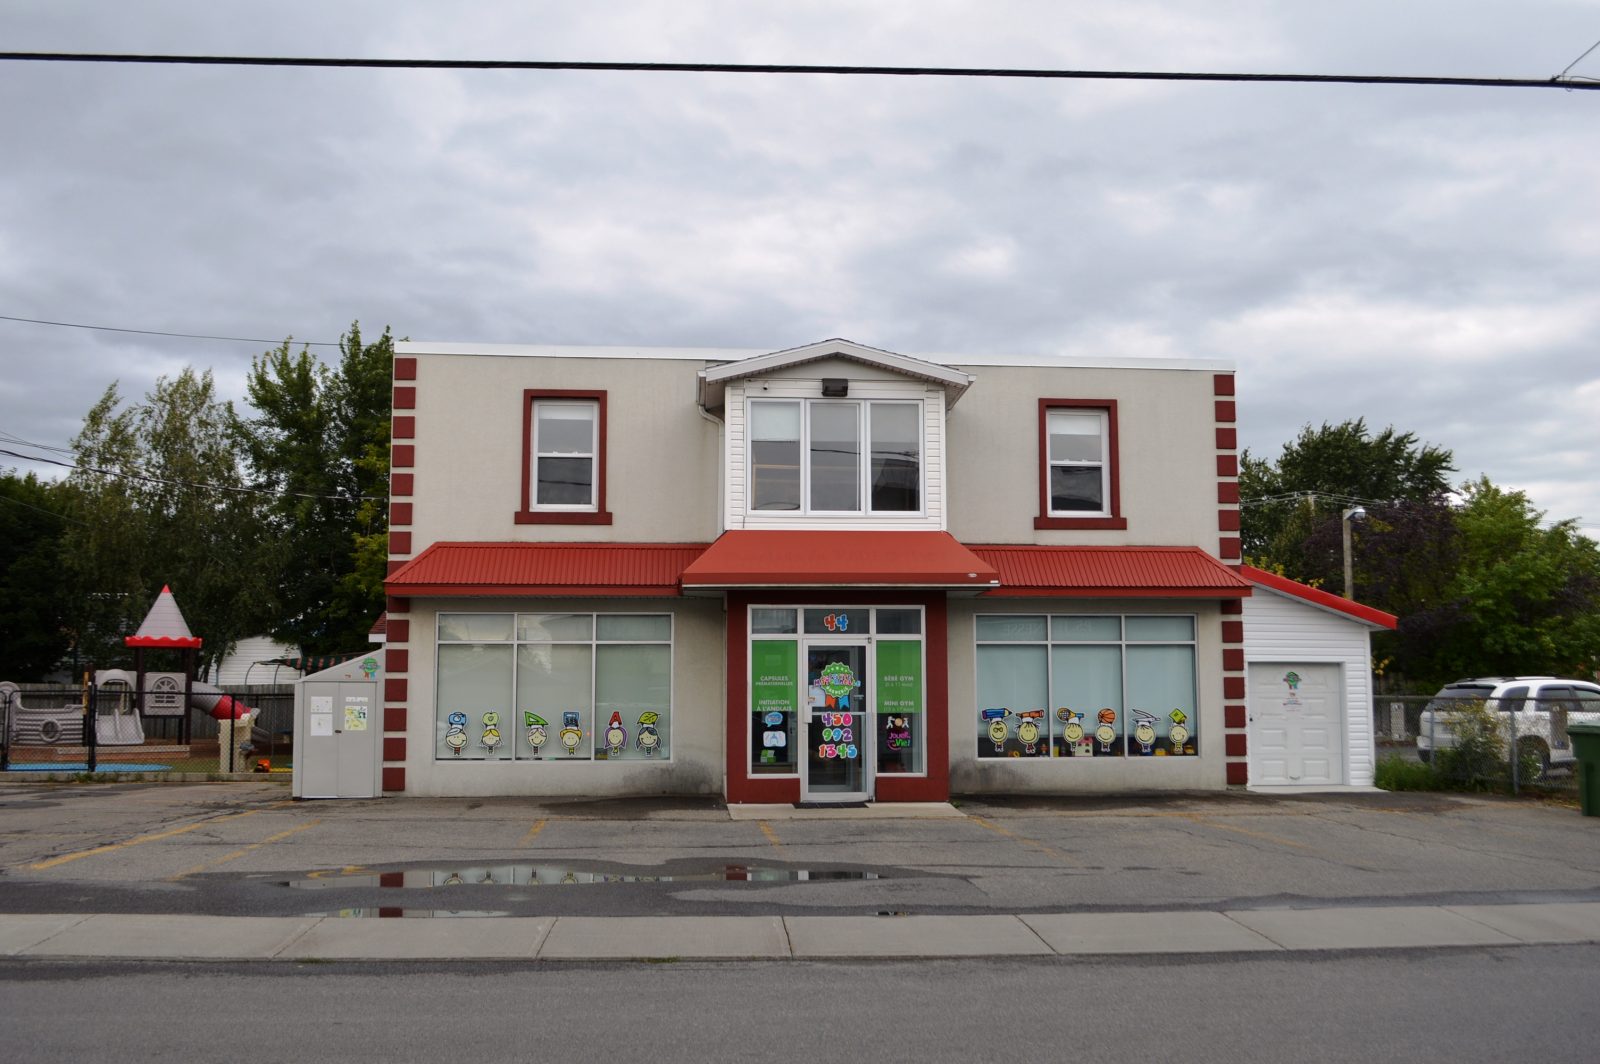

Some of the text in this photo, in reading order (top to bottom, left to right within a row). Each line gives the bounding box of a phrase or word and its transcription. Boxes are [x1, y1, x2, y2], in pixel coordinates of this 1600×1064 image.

[823, 613, 849, 632] 44
[821, 712, 853, 727] 450
[822, 727, 853, 742] 992
[818, 743, 858, 759] 1345
